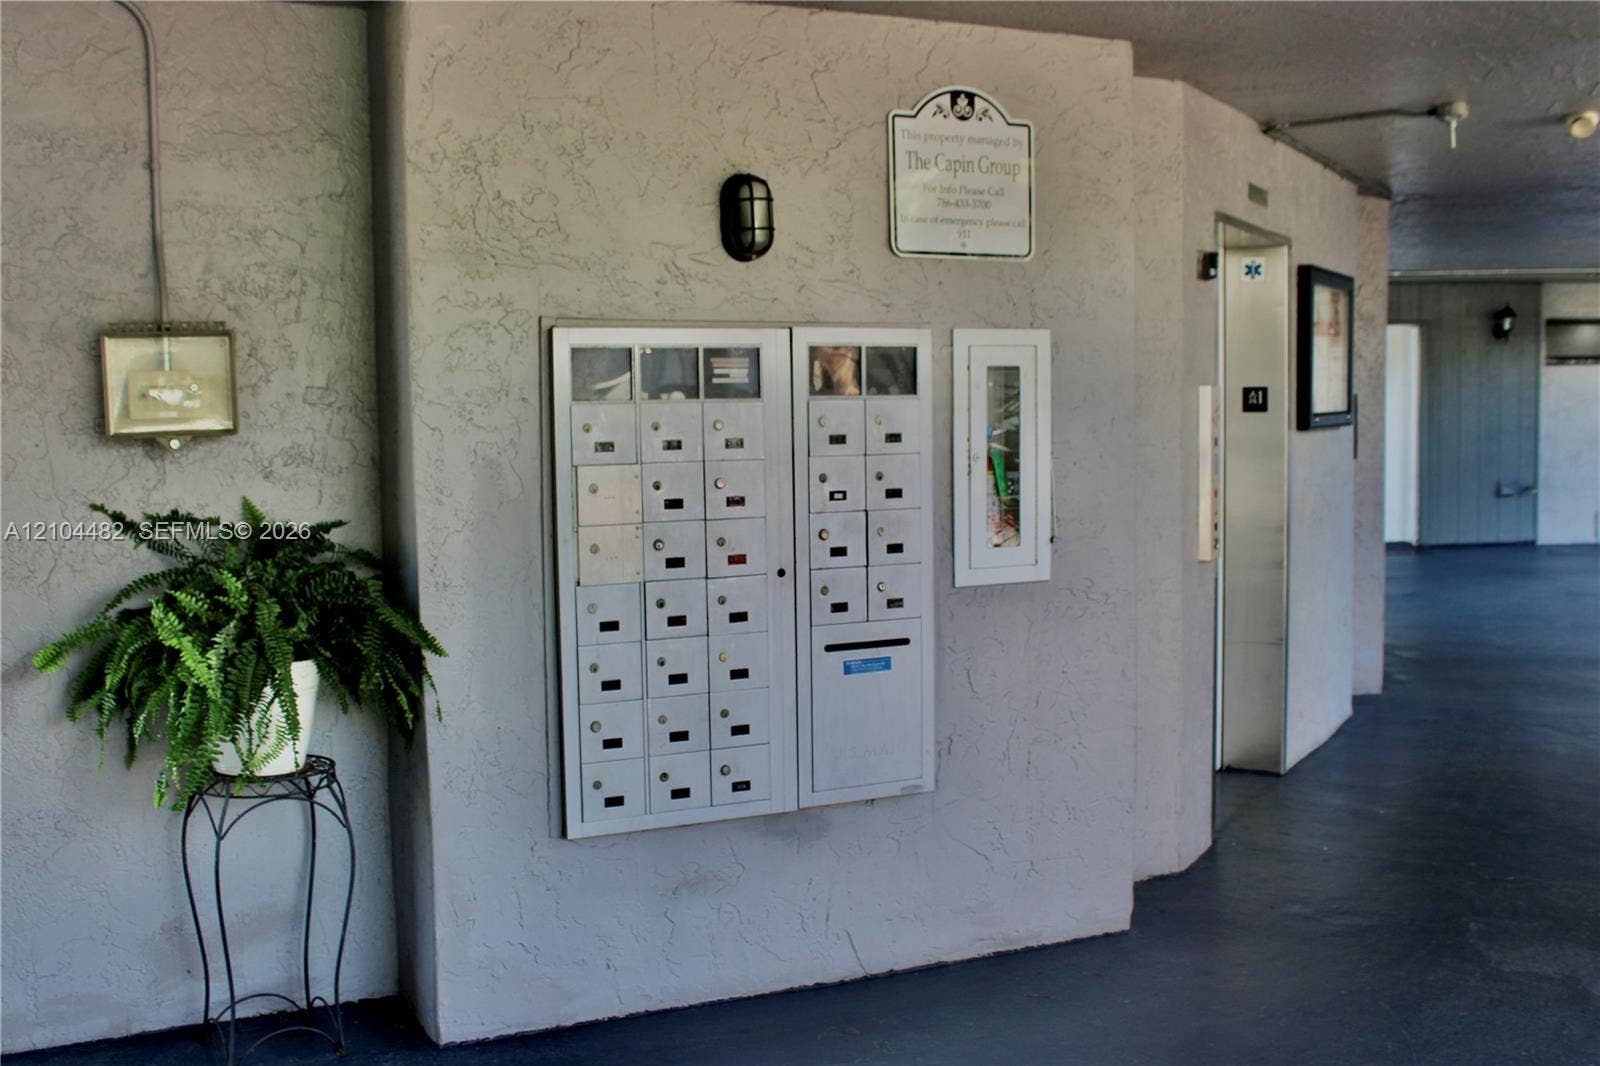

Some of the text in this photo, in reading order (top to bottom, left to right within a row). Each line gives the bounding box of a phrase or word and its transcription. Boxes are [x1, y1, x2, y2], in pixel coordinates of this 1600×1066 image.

[901, 128, 1024, 149] This property managed by
[904, 150, 1021, 182] The Capin Group
[922, 183, 1006, 197] For Info Please Call
[940, 217, 984, 229] emergency
[986, 217, 1011, 229] please
